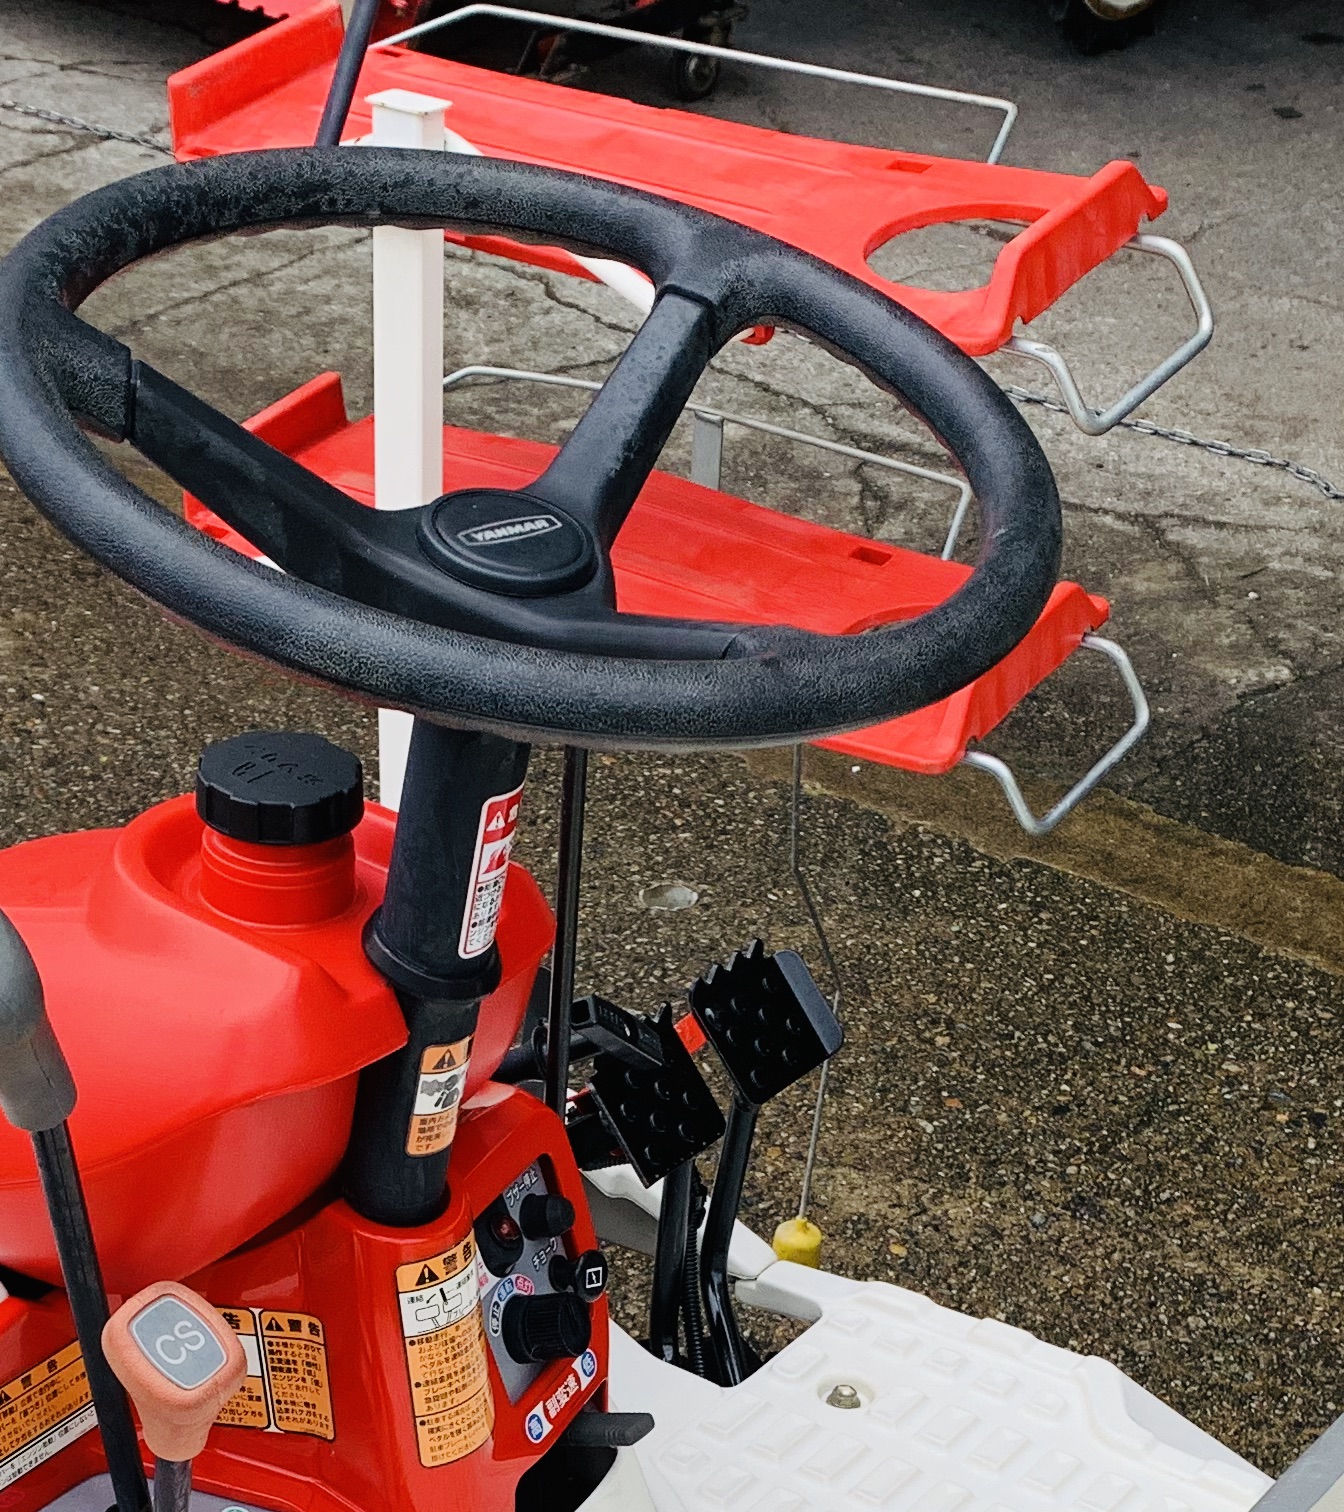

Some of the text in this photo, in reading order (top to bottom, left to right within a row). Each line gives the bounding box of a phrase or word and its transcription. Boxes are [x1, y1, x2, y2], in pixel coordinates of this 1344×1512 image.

[472, 519, 550, 542] YANMAR
[532, 1237, 558, 1270] チョーク
[156, 1320, 206, 1365] CS
[287, 1319, 321, 1338] 警告
[545, 1373, 579, 1419] 副変速
